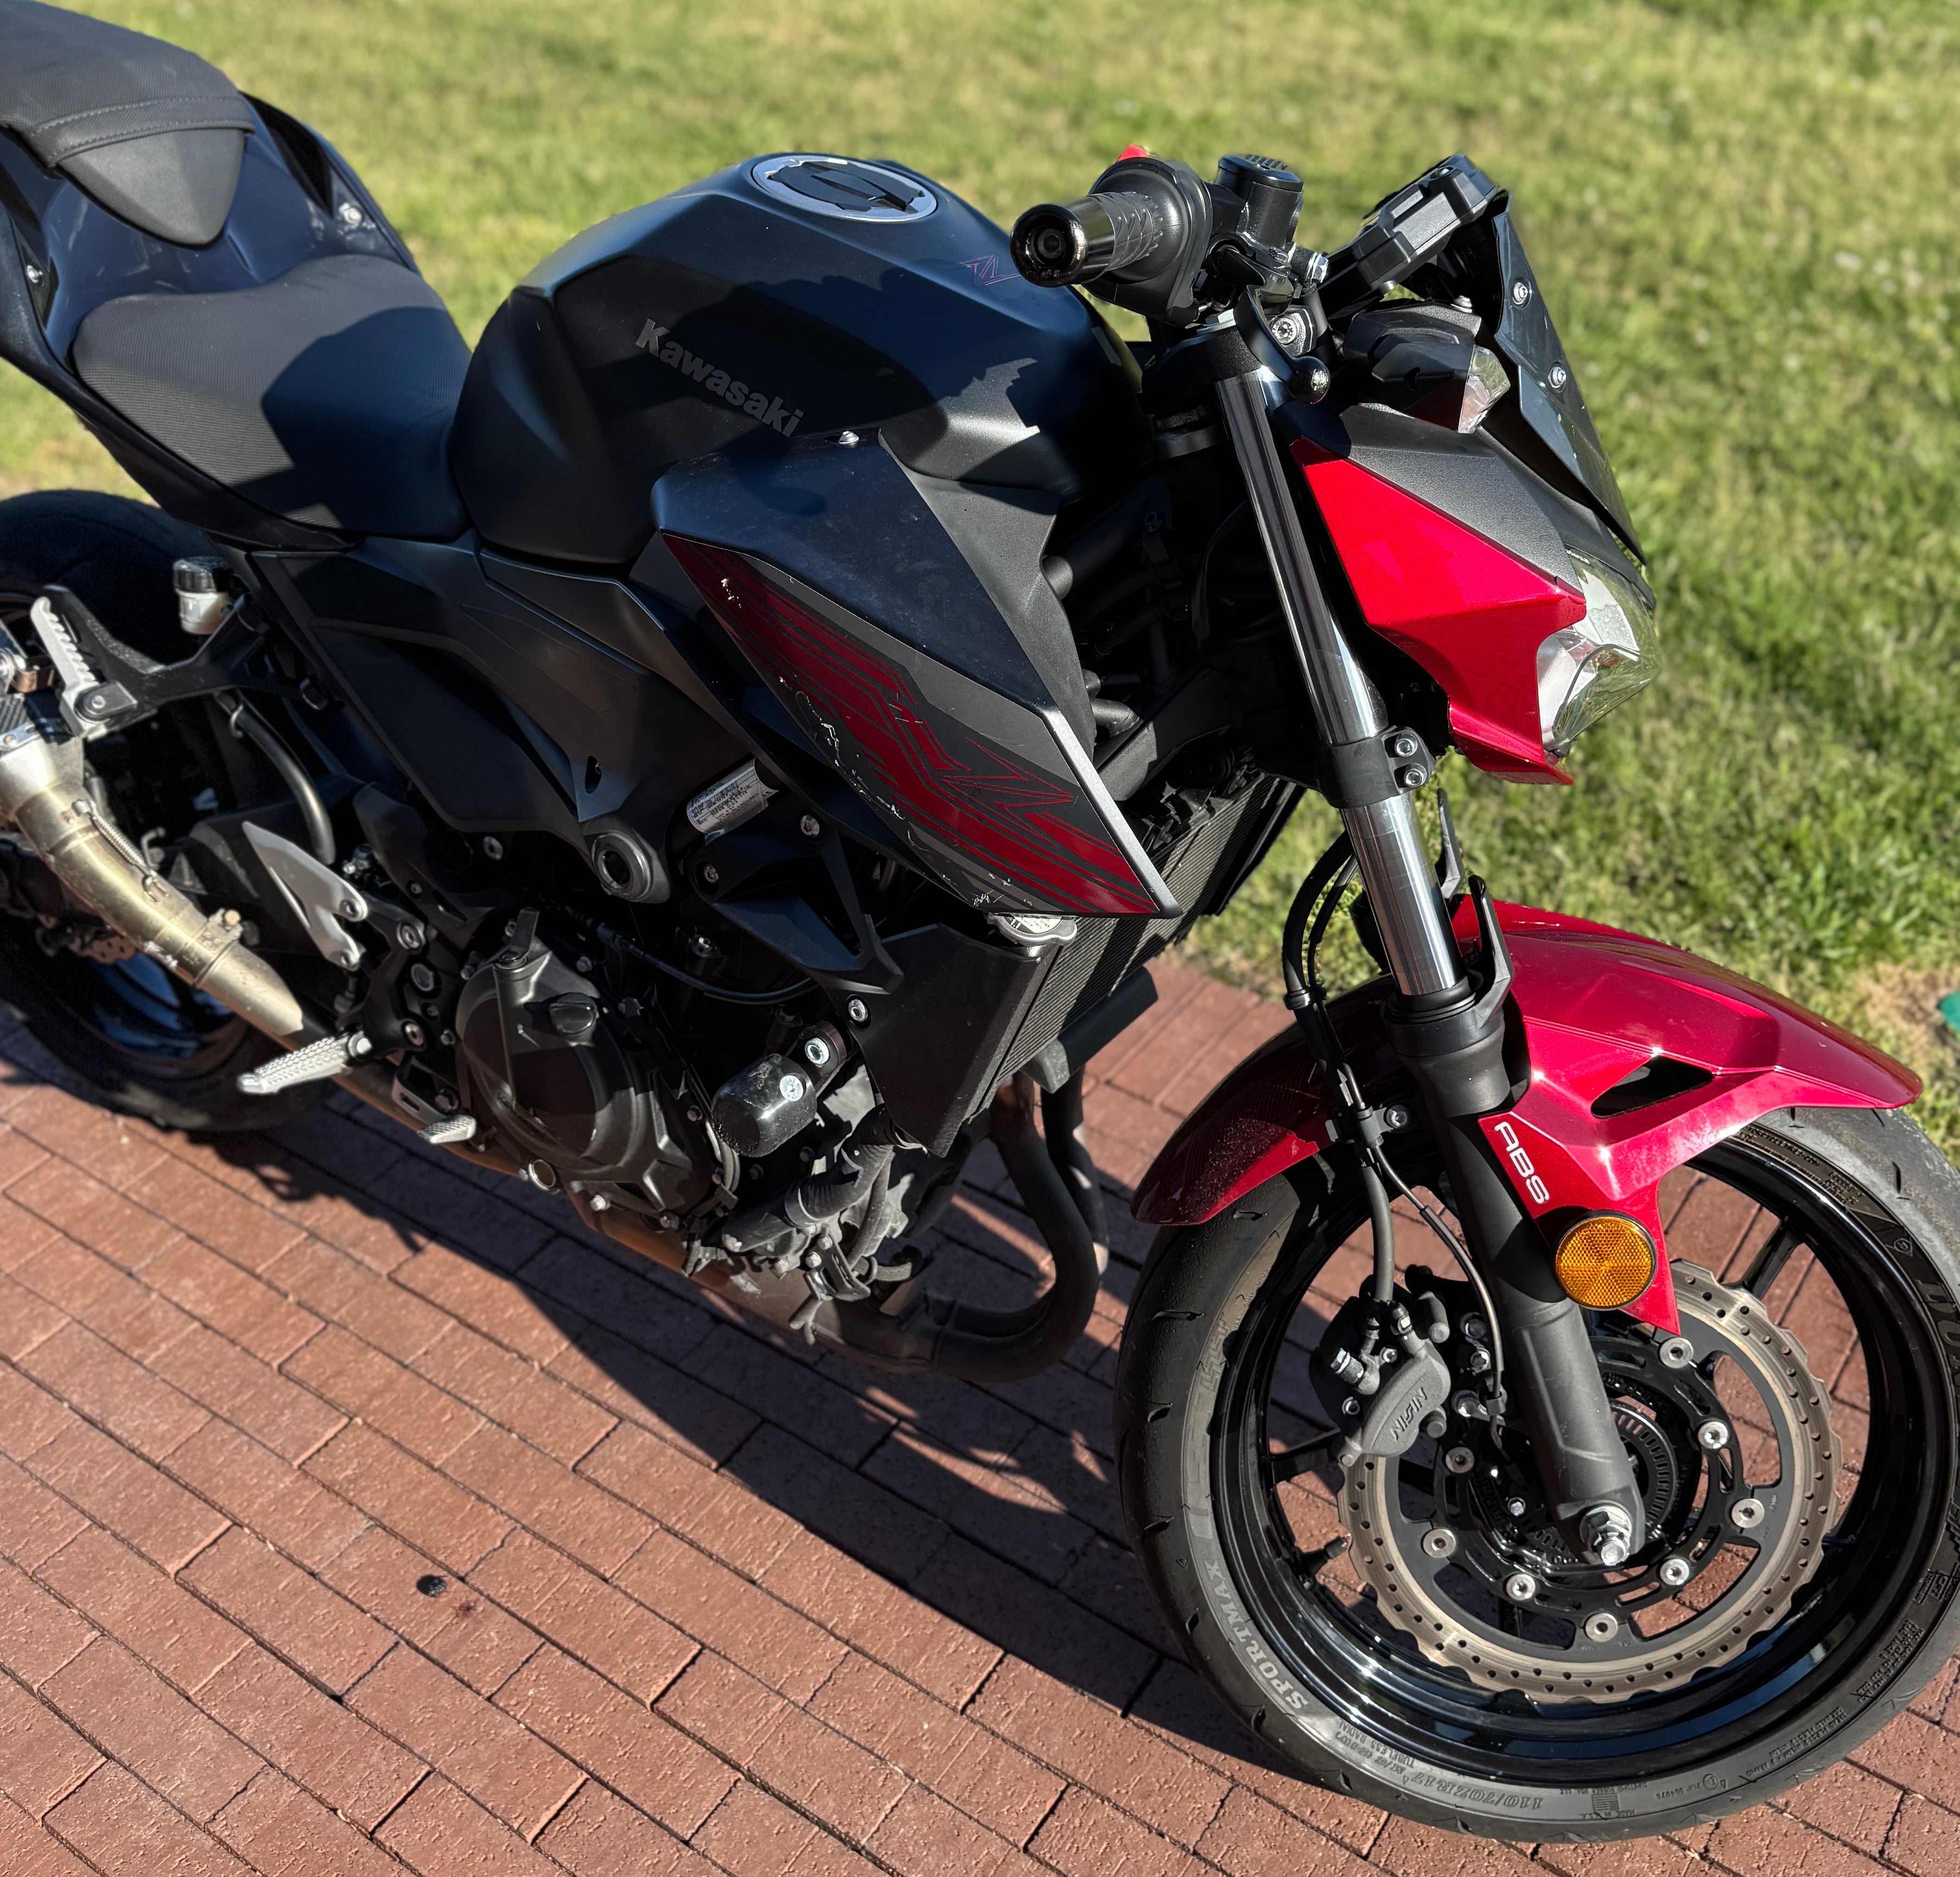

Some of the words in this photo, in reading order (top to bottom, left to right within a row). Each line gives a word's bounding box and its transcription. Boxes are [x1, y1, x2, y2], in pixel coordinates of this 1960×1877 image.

[635, 318, 804, 438] Kawasaki
[1494, 1121, 1550, 1204] ABS
[1204, 1560, 1310, 1712] SPORTMAX
[1338, 1721, 1366, 1744] RADIAL
[1370, 1740, 1413, 1768] TUBELESS
[1411, 1772, 1545, 1809] 110/70ZR17
